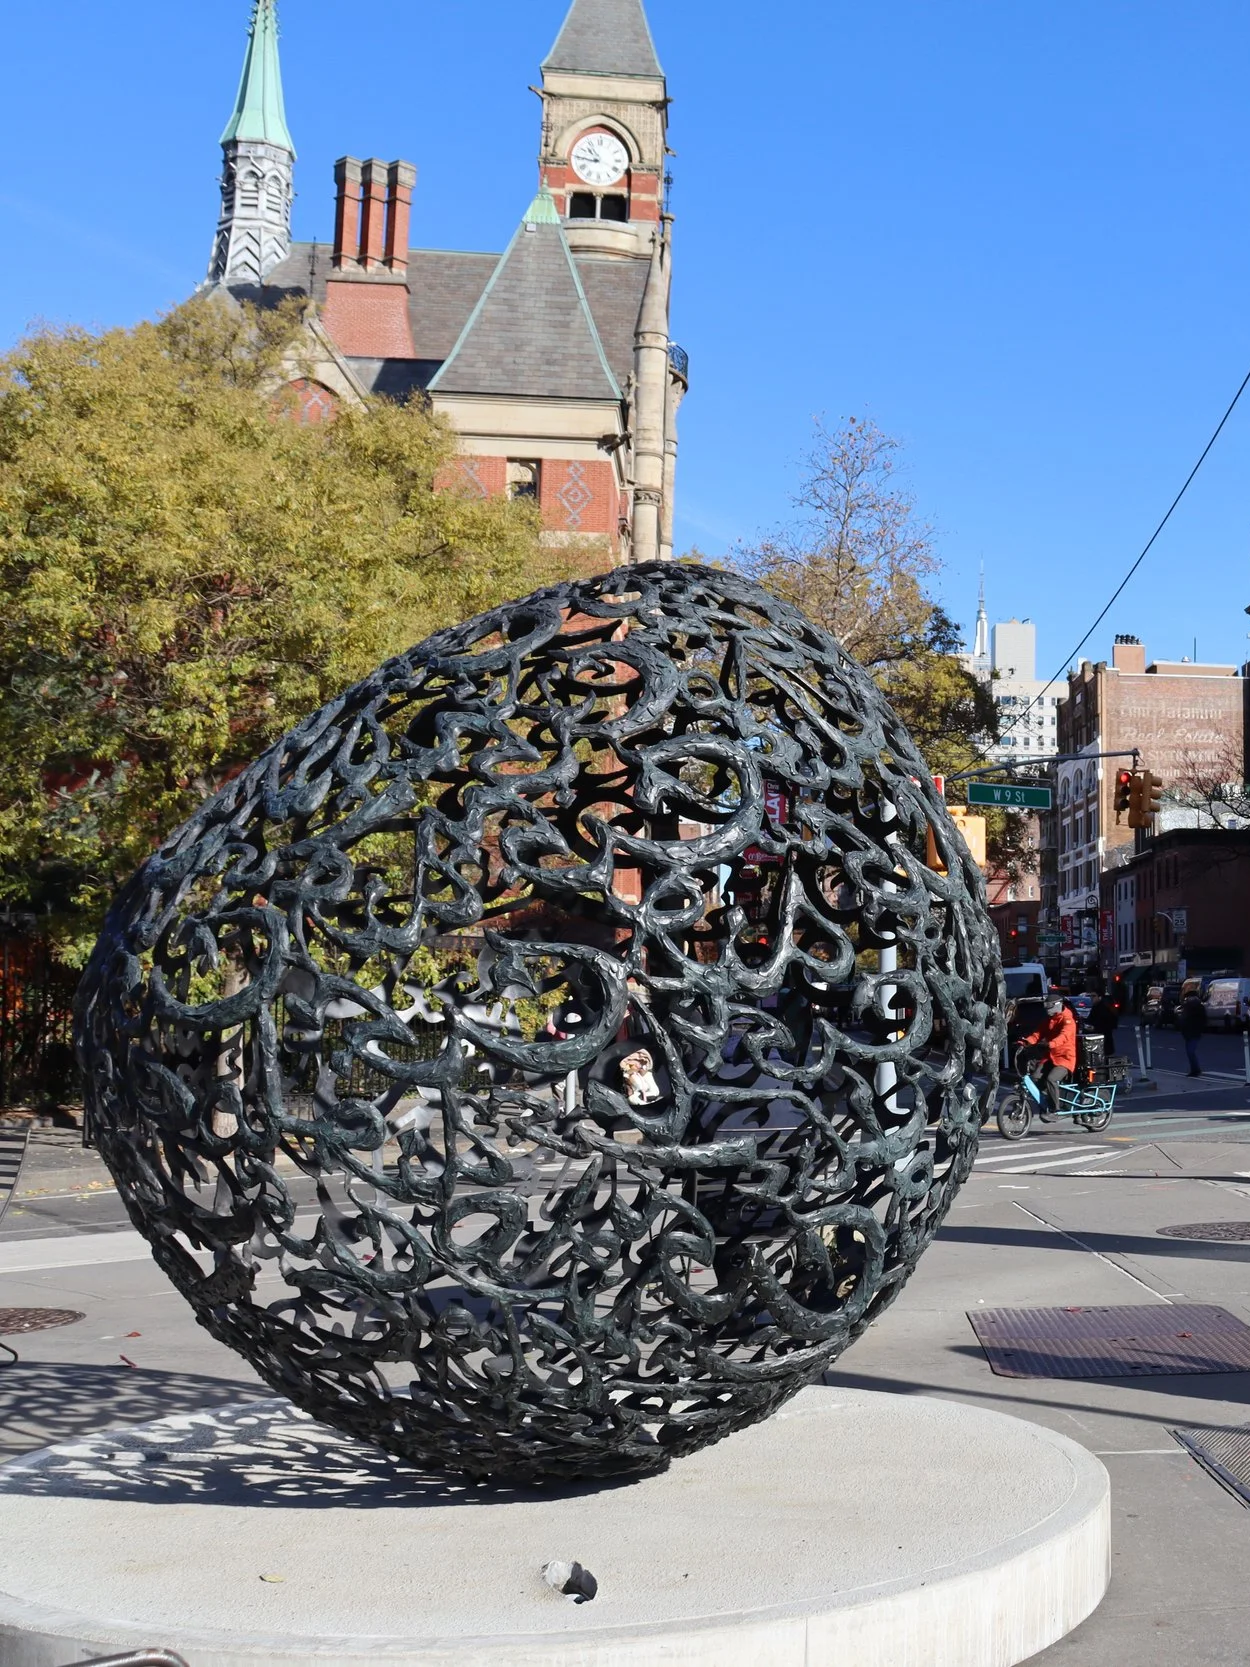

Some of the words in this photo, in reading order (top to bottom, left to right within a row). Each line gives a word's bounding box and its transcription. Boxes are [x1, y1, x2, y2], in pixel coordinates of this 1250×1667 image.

[993, 789, 1001, 801] W
[1005, 790, 1011, 801] 9
[1015, 791, 1026, 803] St
